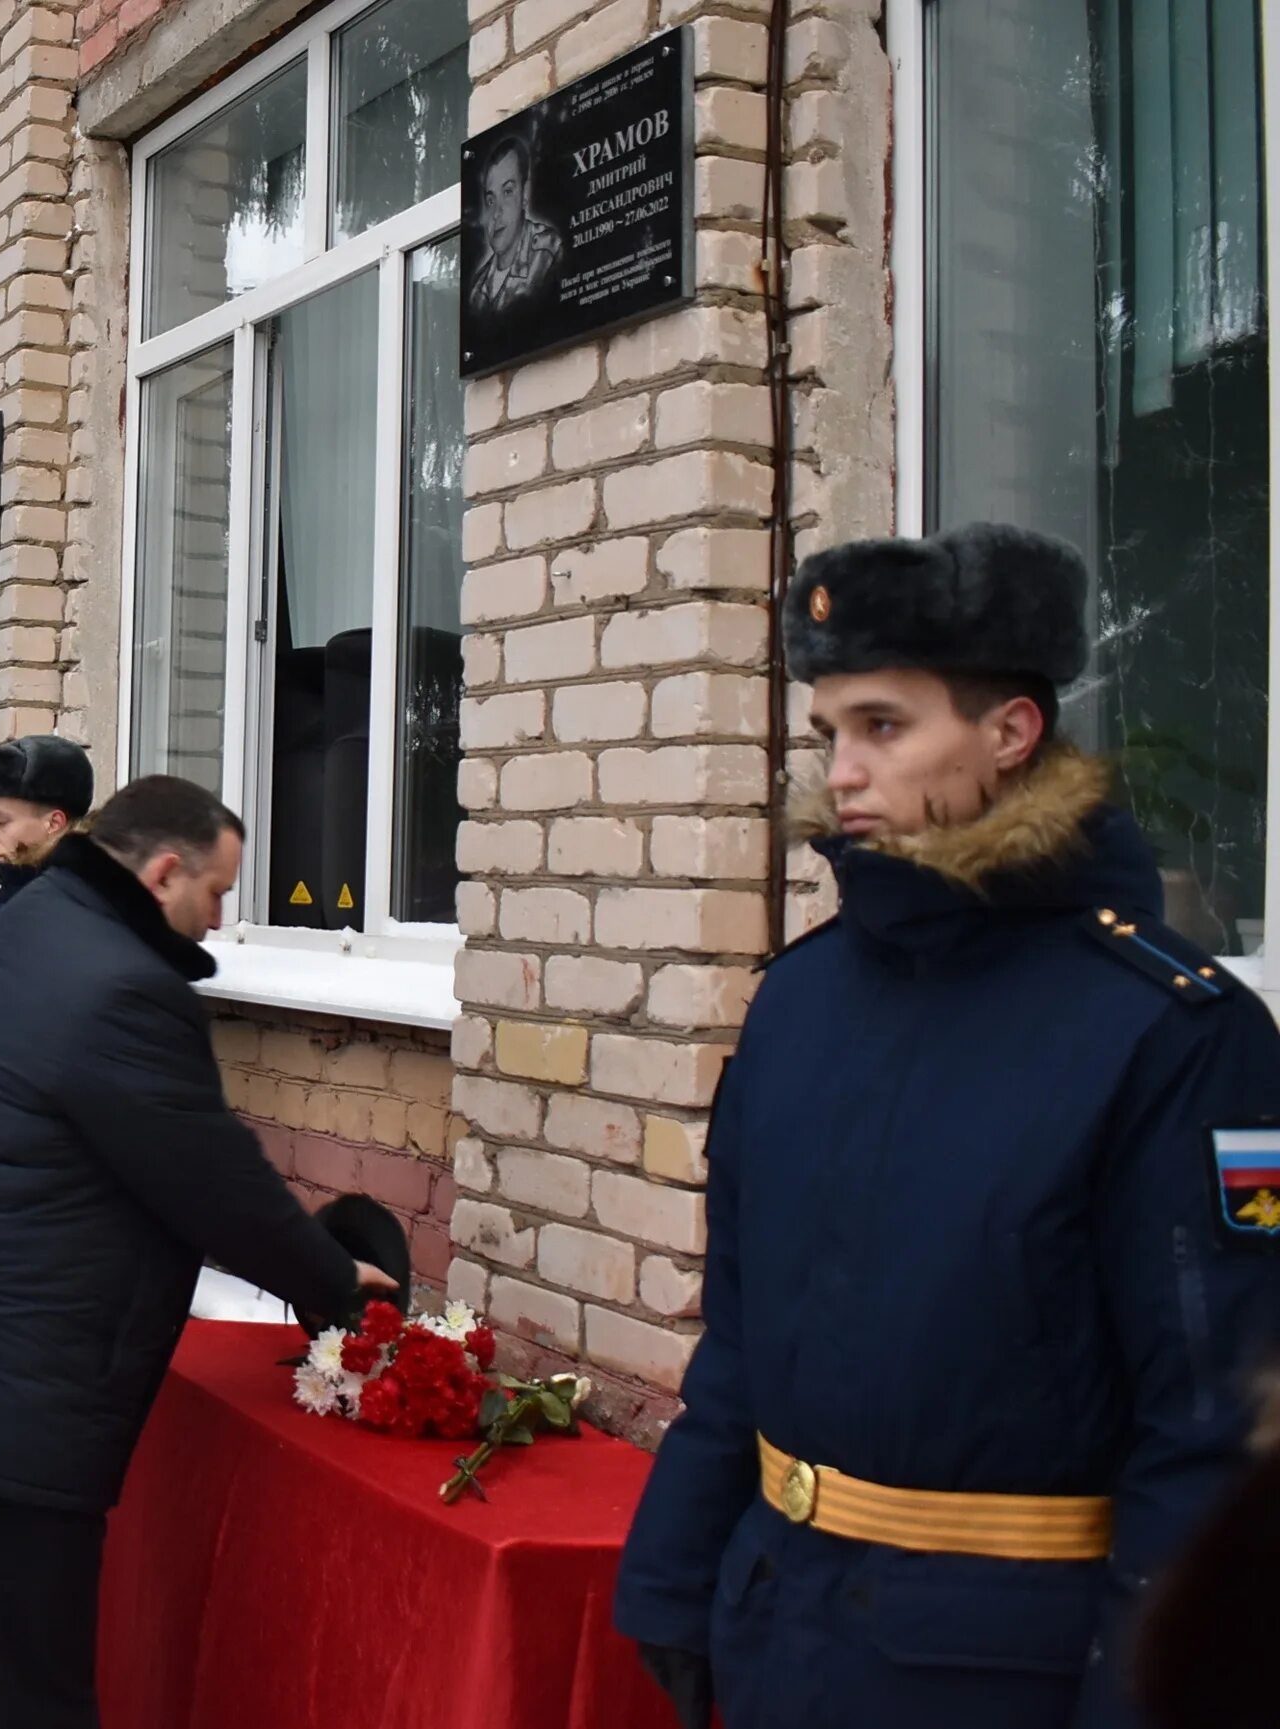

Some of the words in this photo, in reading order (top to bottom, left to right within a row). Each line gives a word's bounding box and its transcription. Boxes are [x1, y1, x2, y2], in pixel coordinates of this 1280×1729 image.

[572, 109, 670, 178] ХРАМОВ
[569, 171, 674, 229] АЛЕКСАНДРОВИЧ
[586, 153, 647, 197] ДМИТРИЙ
[572, 219, 615, 248] 20.11.1990
[624, 196, 669, 226] 27.06.2022
